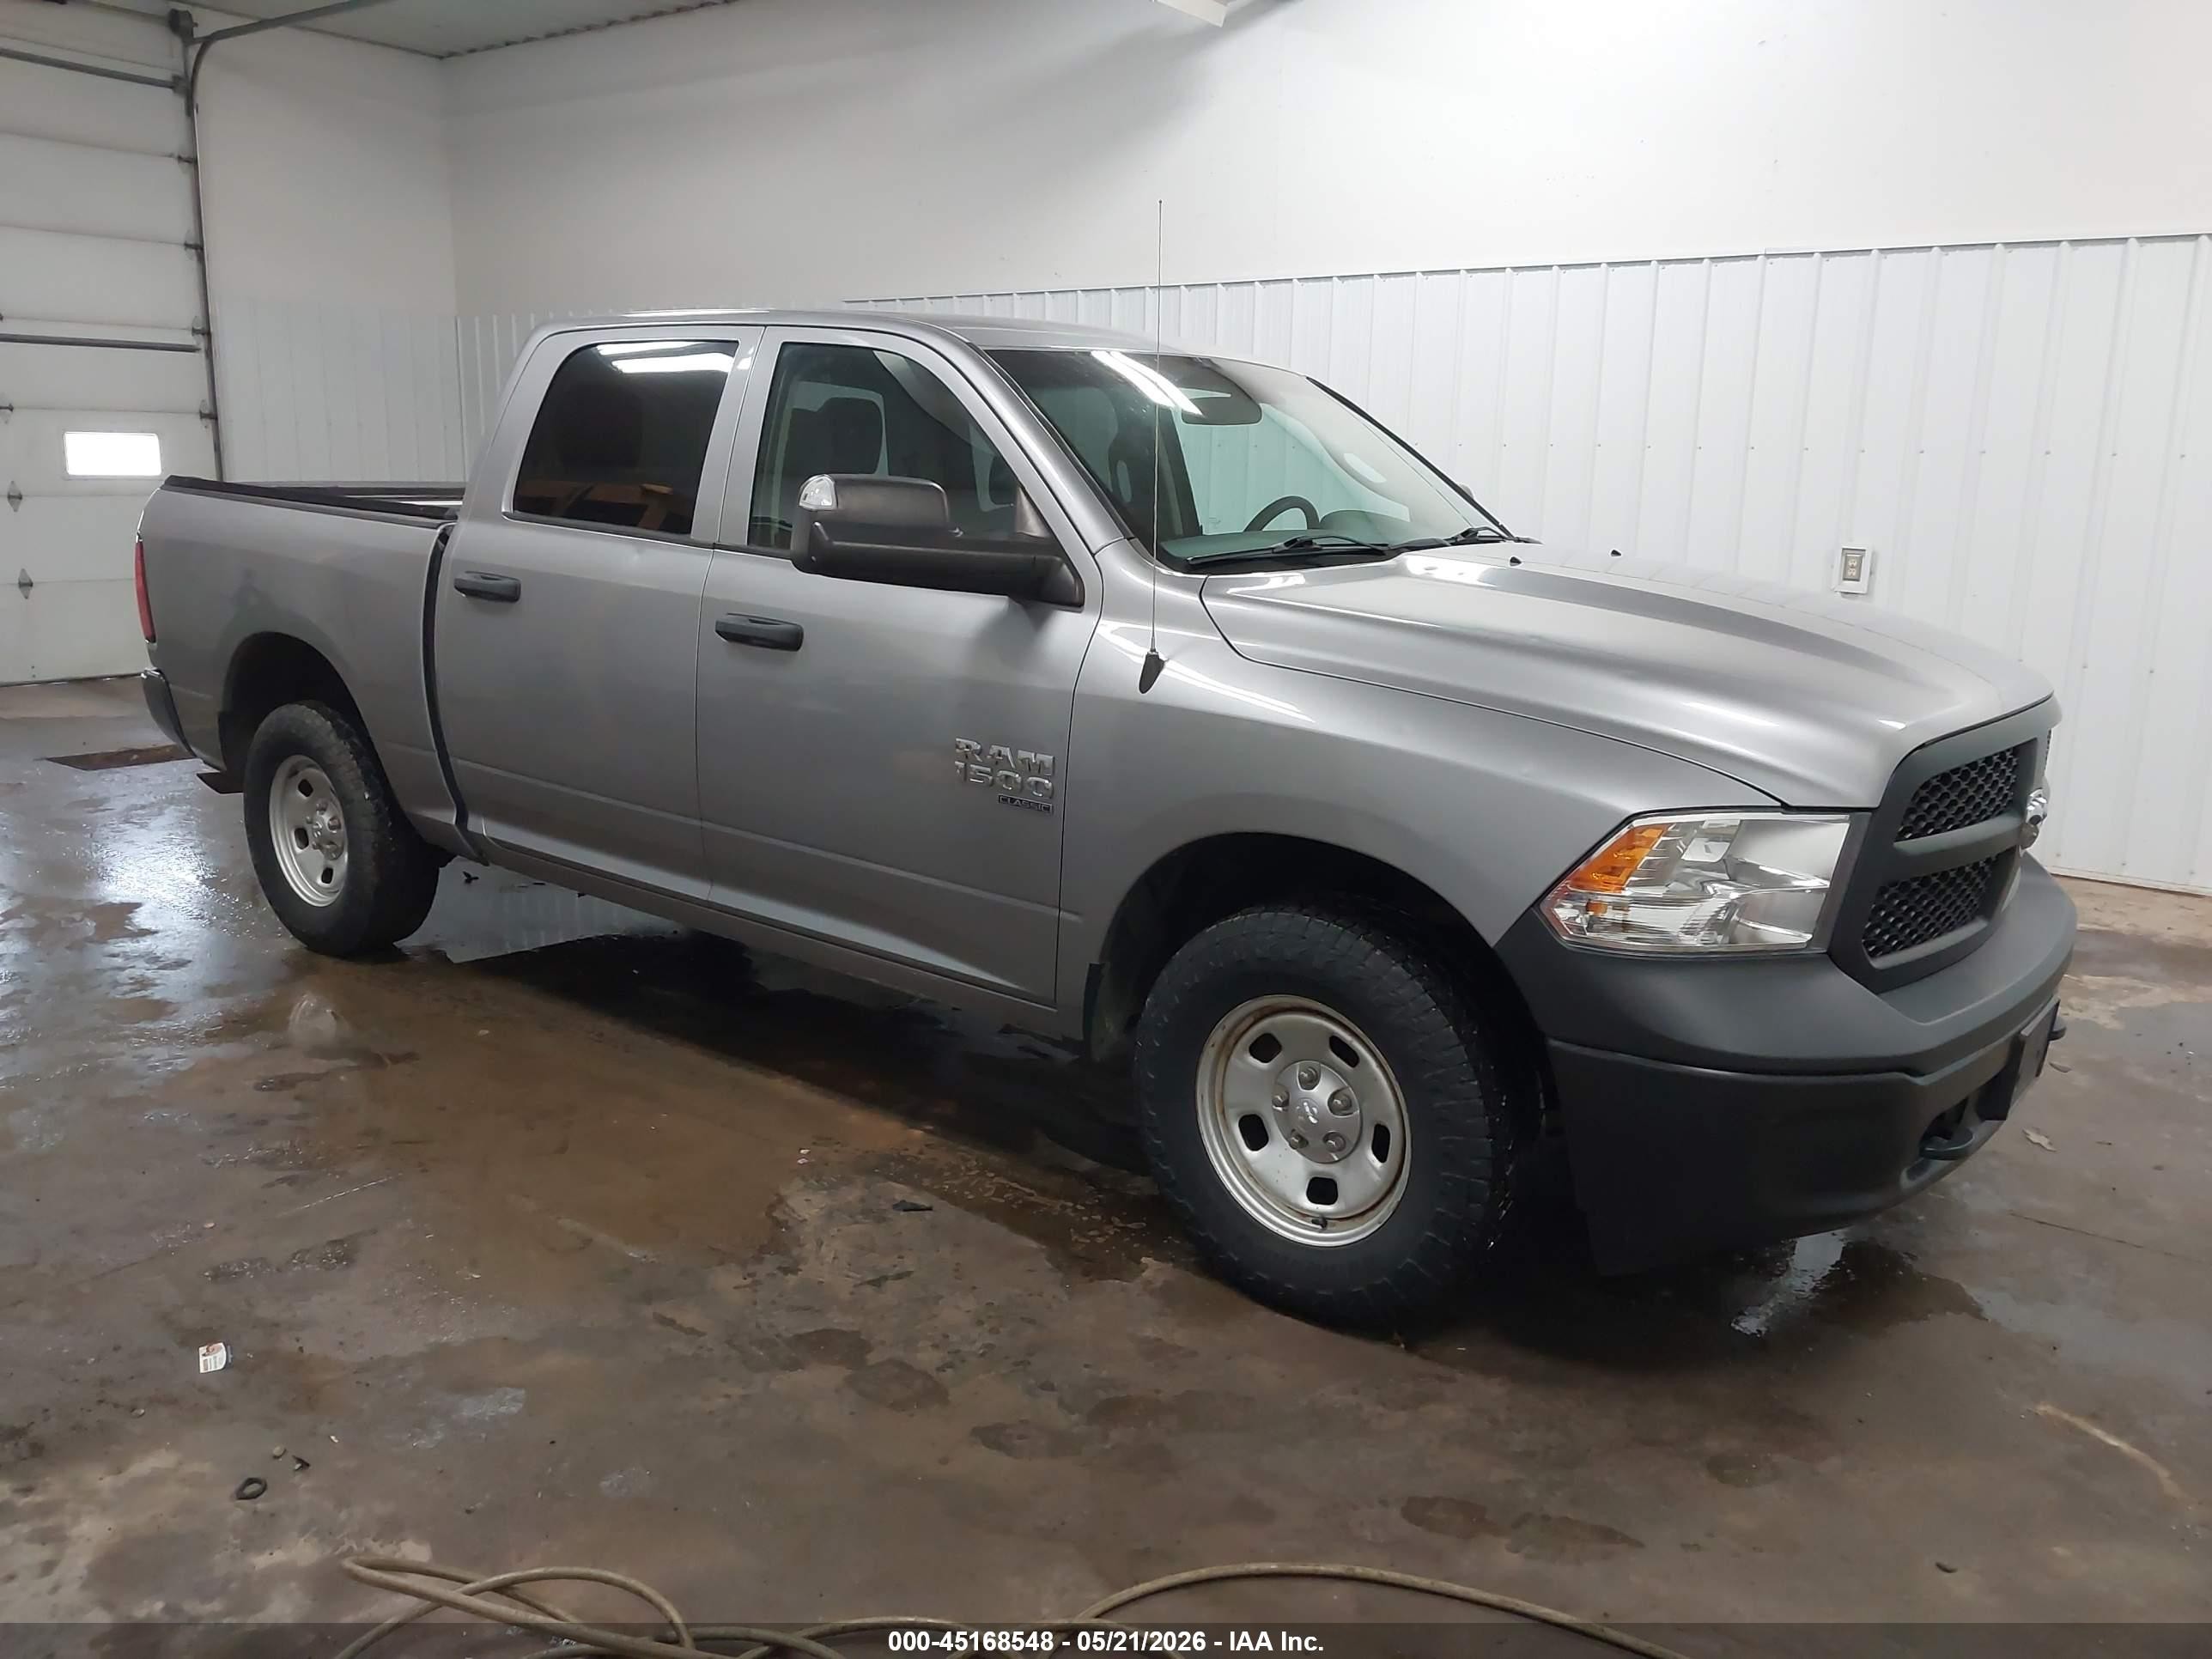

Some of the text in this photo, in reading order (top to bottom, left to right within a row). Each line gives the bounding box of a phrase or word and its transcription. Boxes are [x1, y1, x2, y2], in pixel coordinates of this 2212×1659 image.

[954, 738, 1054, 776] RAM
[954, 761, 1054, 799] 1500
[999, 795, 1052, 812] CLASSIC
